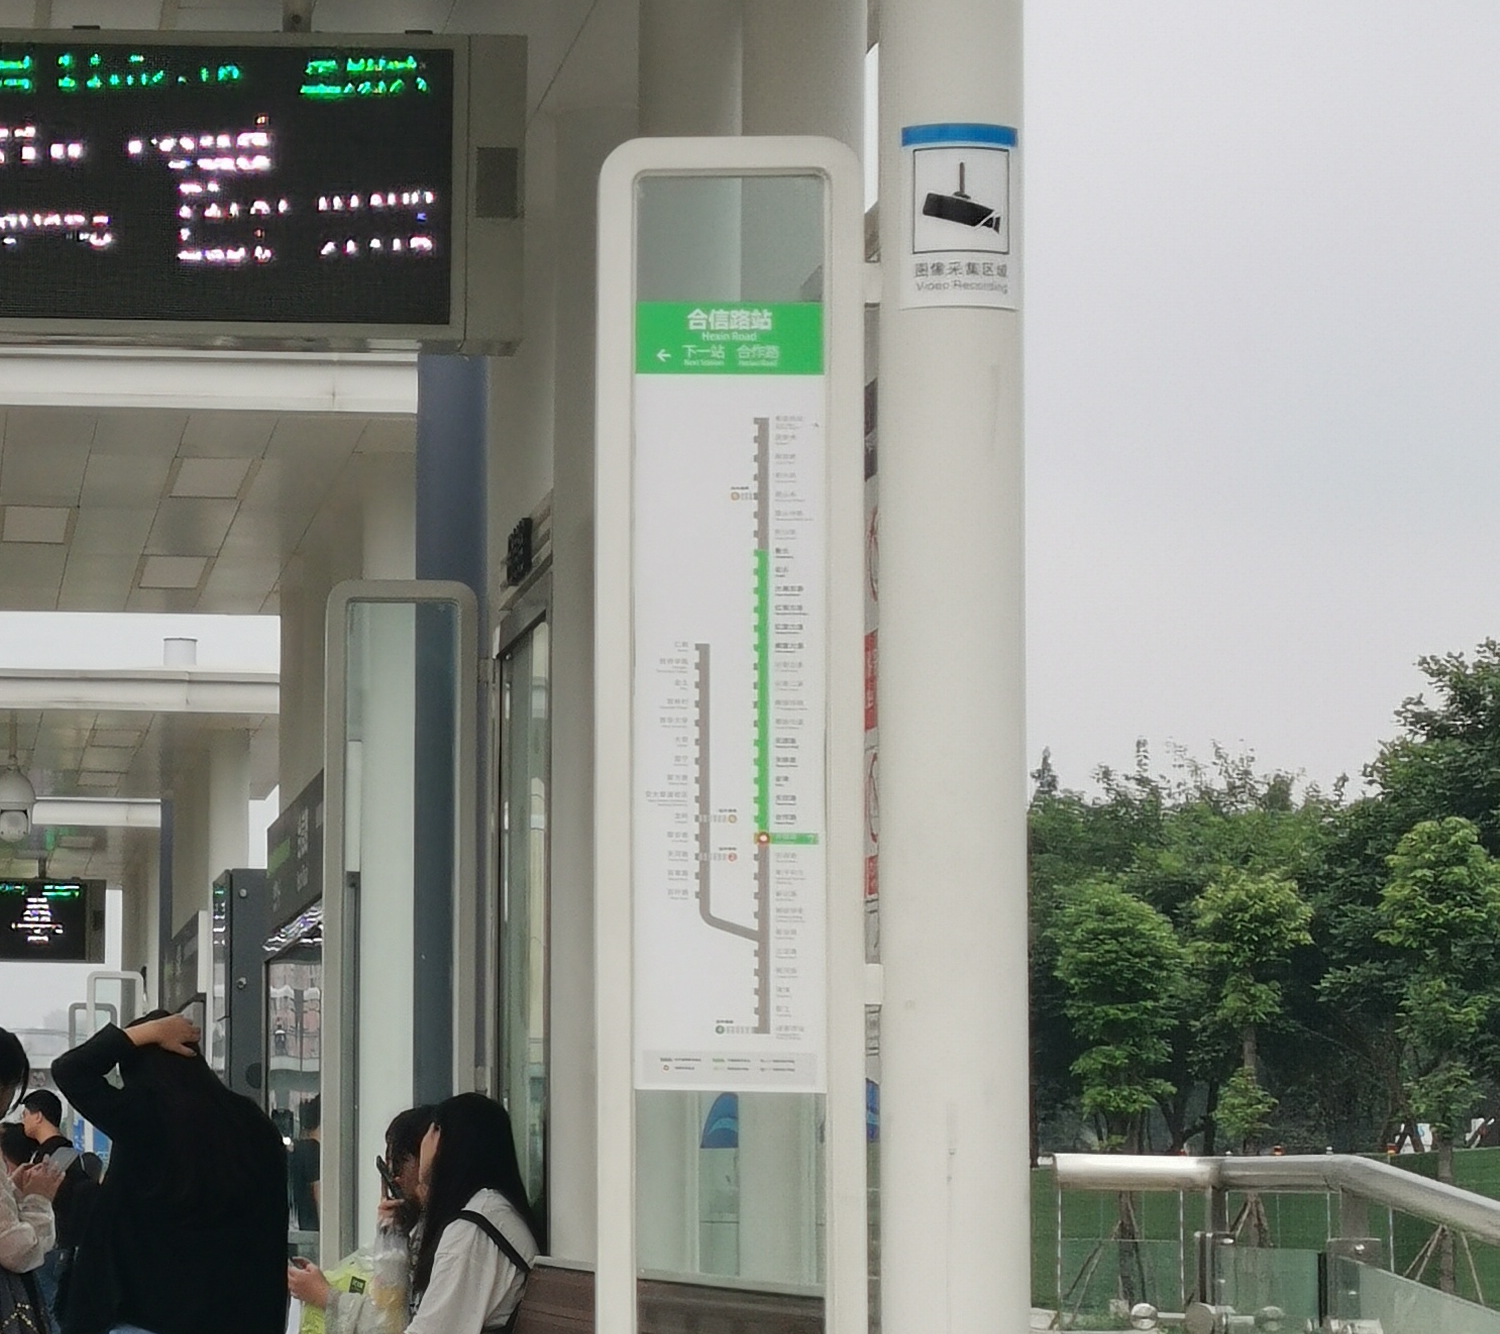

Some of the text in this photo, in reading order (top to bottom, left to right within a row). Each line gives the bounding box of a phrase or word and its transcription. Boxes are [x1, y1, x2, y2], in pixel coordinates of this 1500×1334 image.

[686, 308, 772, 331] 合信路站
[701, 331, 757, 341] Hexin Road
[682, 344, 725, 359] 下一站
